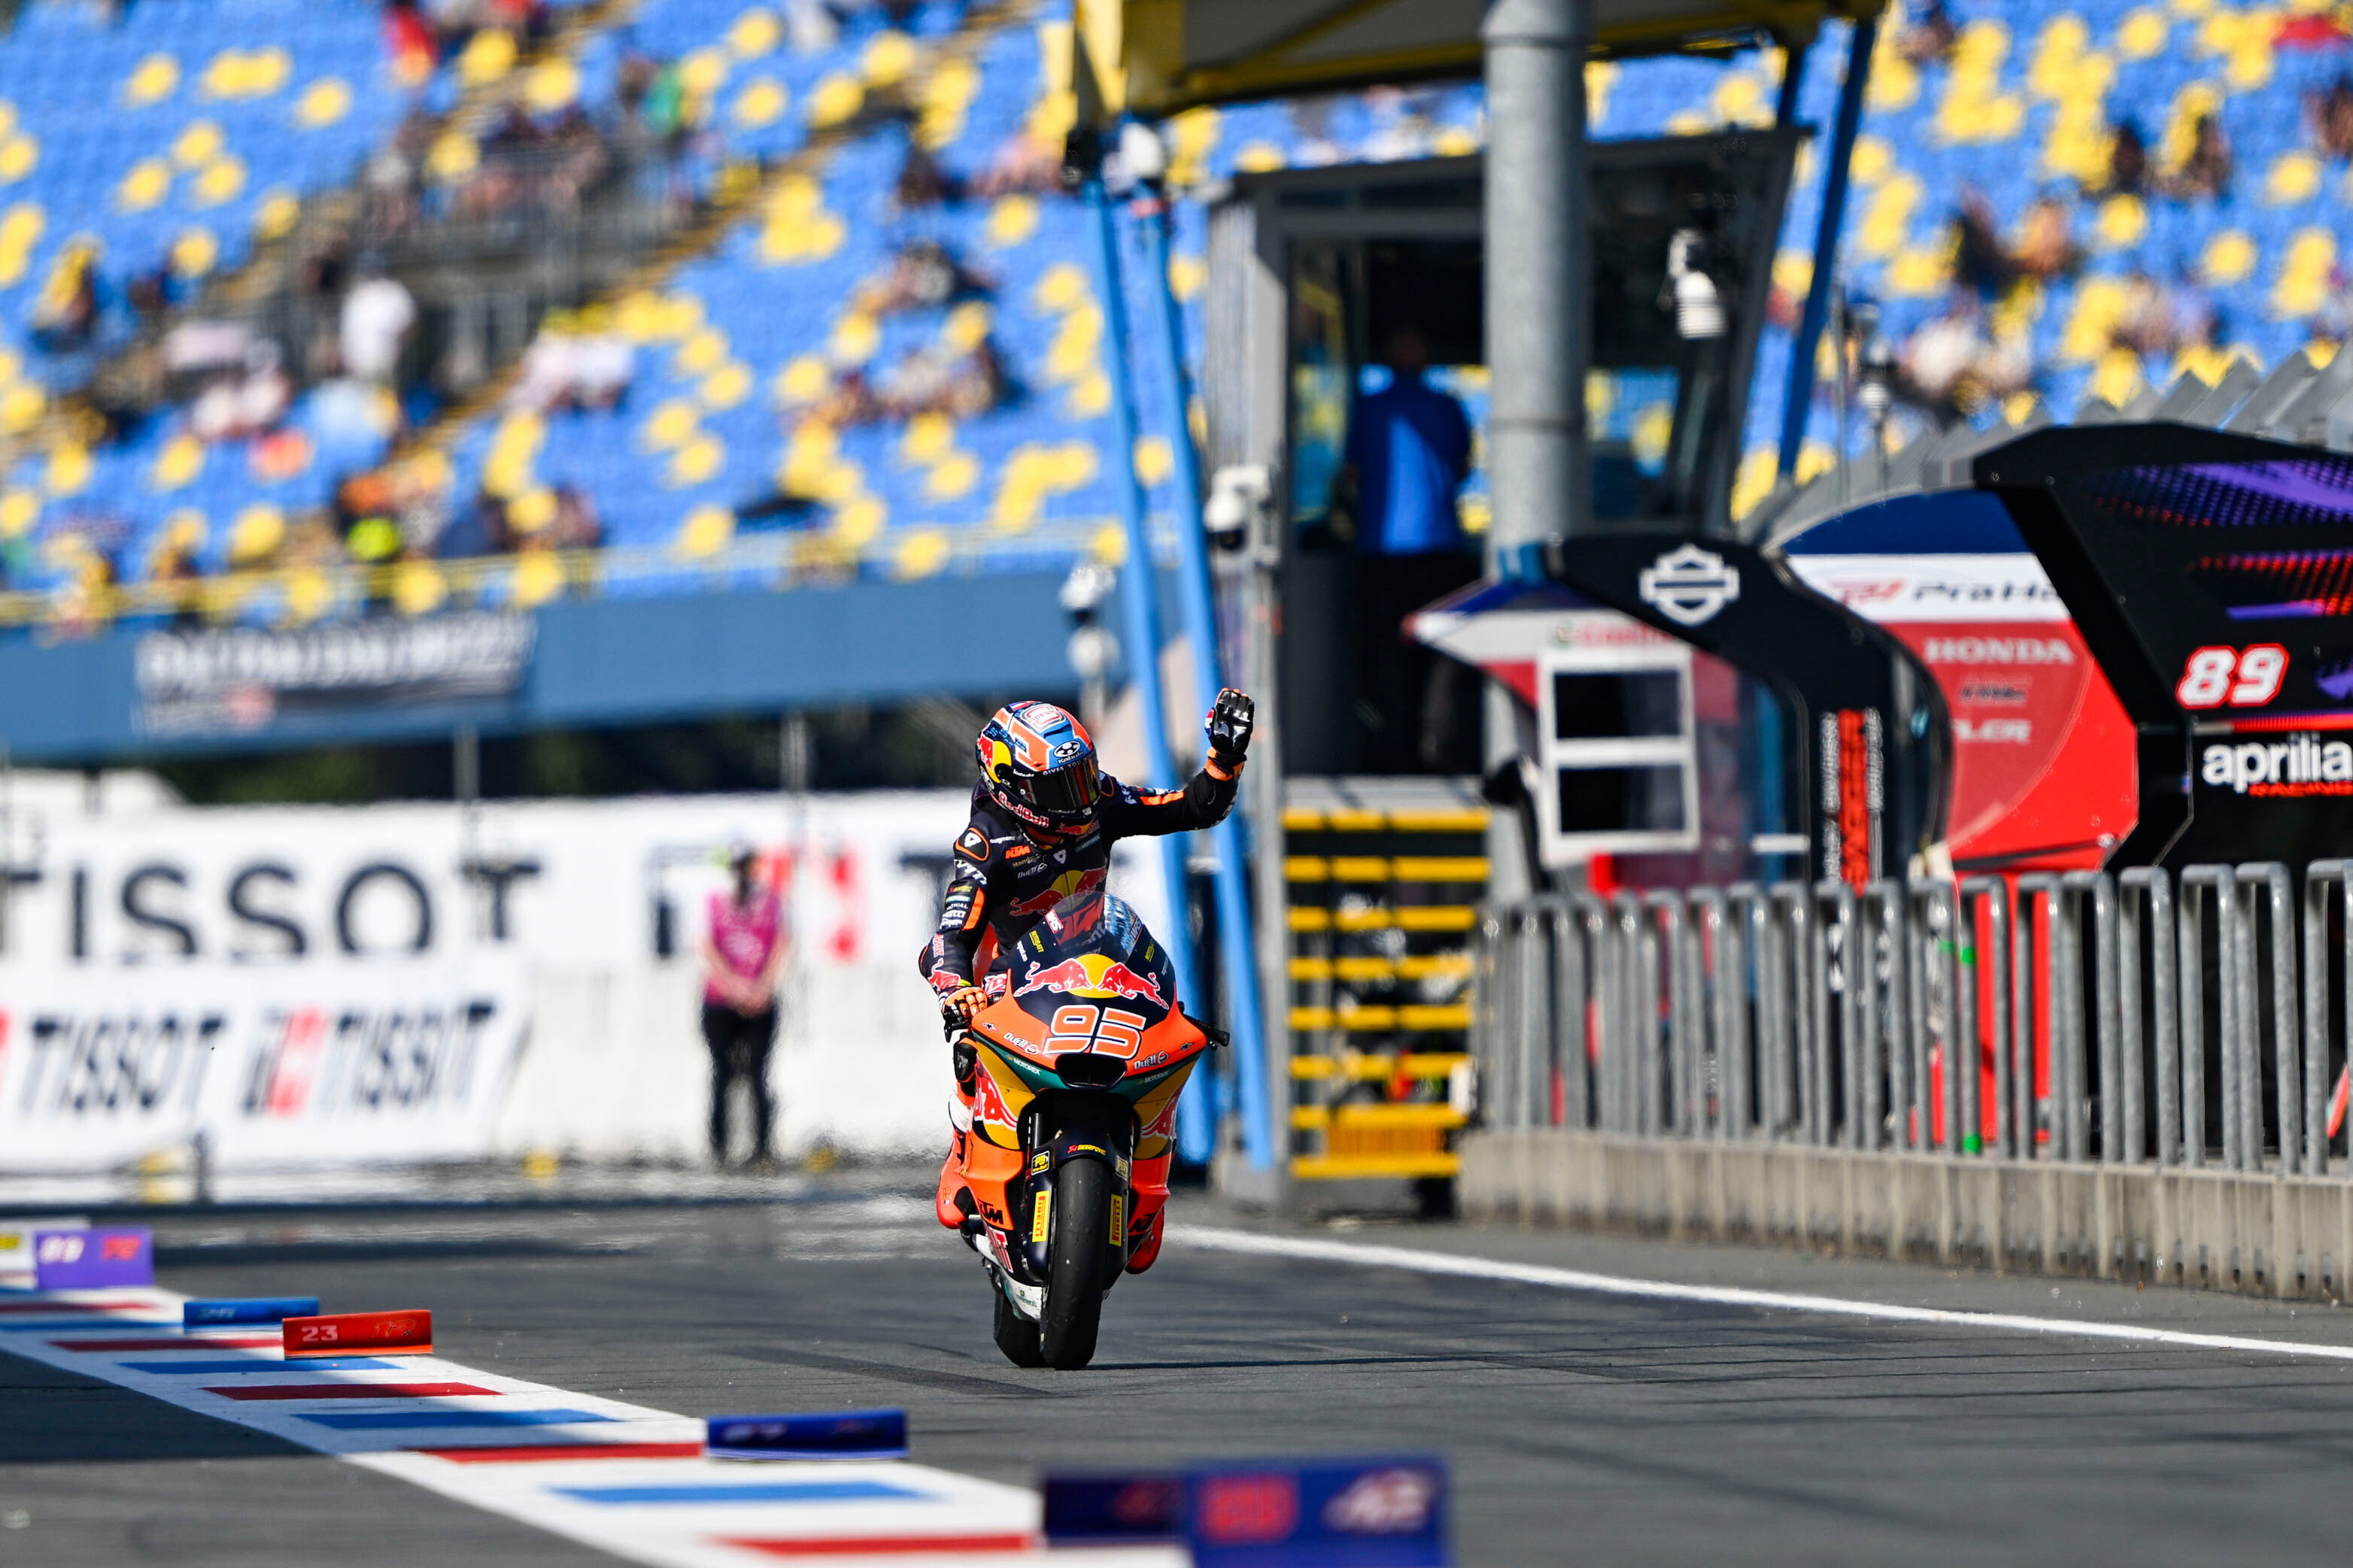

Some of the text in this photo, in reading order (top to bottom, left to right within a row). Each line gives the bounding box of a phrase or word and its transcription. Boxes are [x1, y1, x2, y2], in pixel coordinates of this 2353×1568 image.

[1924, 637, 2075, 666] HONDA
[2176, 642, 2290, 710] 89
[1043, 760, 1082, 775] GIVES YOU
[2202, 731, 2353, 794] aprilia
[998, 790, 1049, 828] Red Bull
[1005, 845, 1031, 859] KTM
[1043, 1004, 1146, 1060] 95
[19, 1015, 223, 1113] TISSOT
[1035, 1195, 1046, 1237] PIRELLI
[1113, 1199, 1121, 1242] PIRELLI
[301, 1324, 339, 1342] 23
